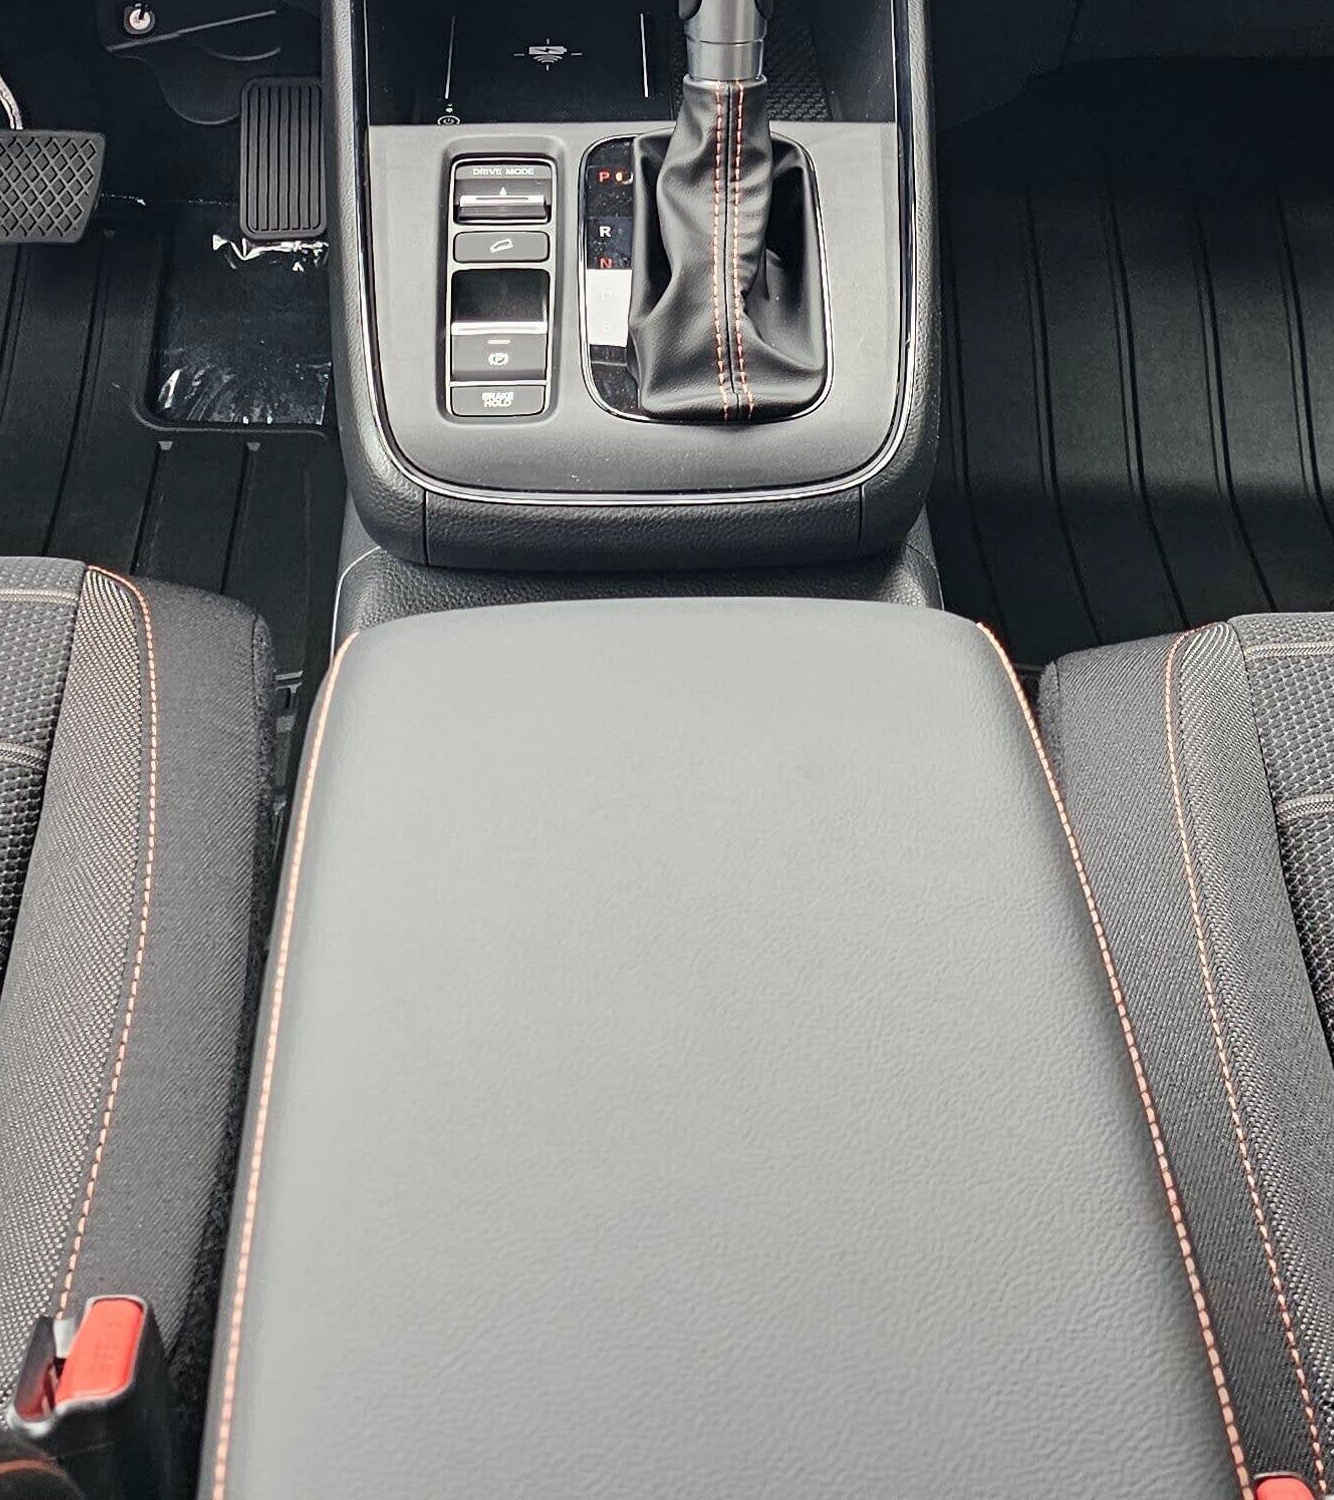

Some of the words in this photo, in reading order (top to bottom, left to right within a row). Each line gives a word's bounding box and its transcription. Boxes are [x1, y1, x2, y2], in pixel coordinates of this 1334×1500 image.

[472, 167, 501, 176] DRIVE
[505, 167, 535, 176] MODE
[598, 171, 610, 183] P
[599, 225, 612, 238] R
[599, 257, 613, 269] N
